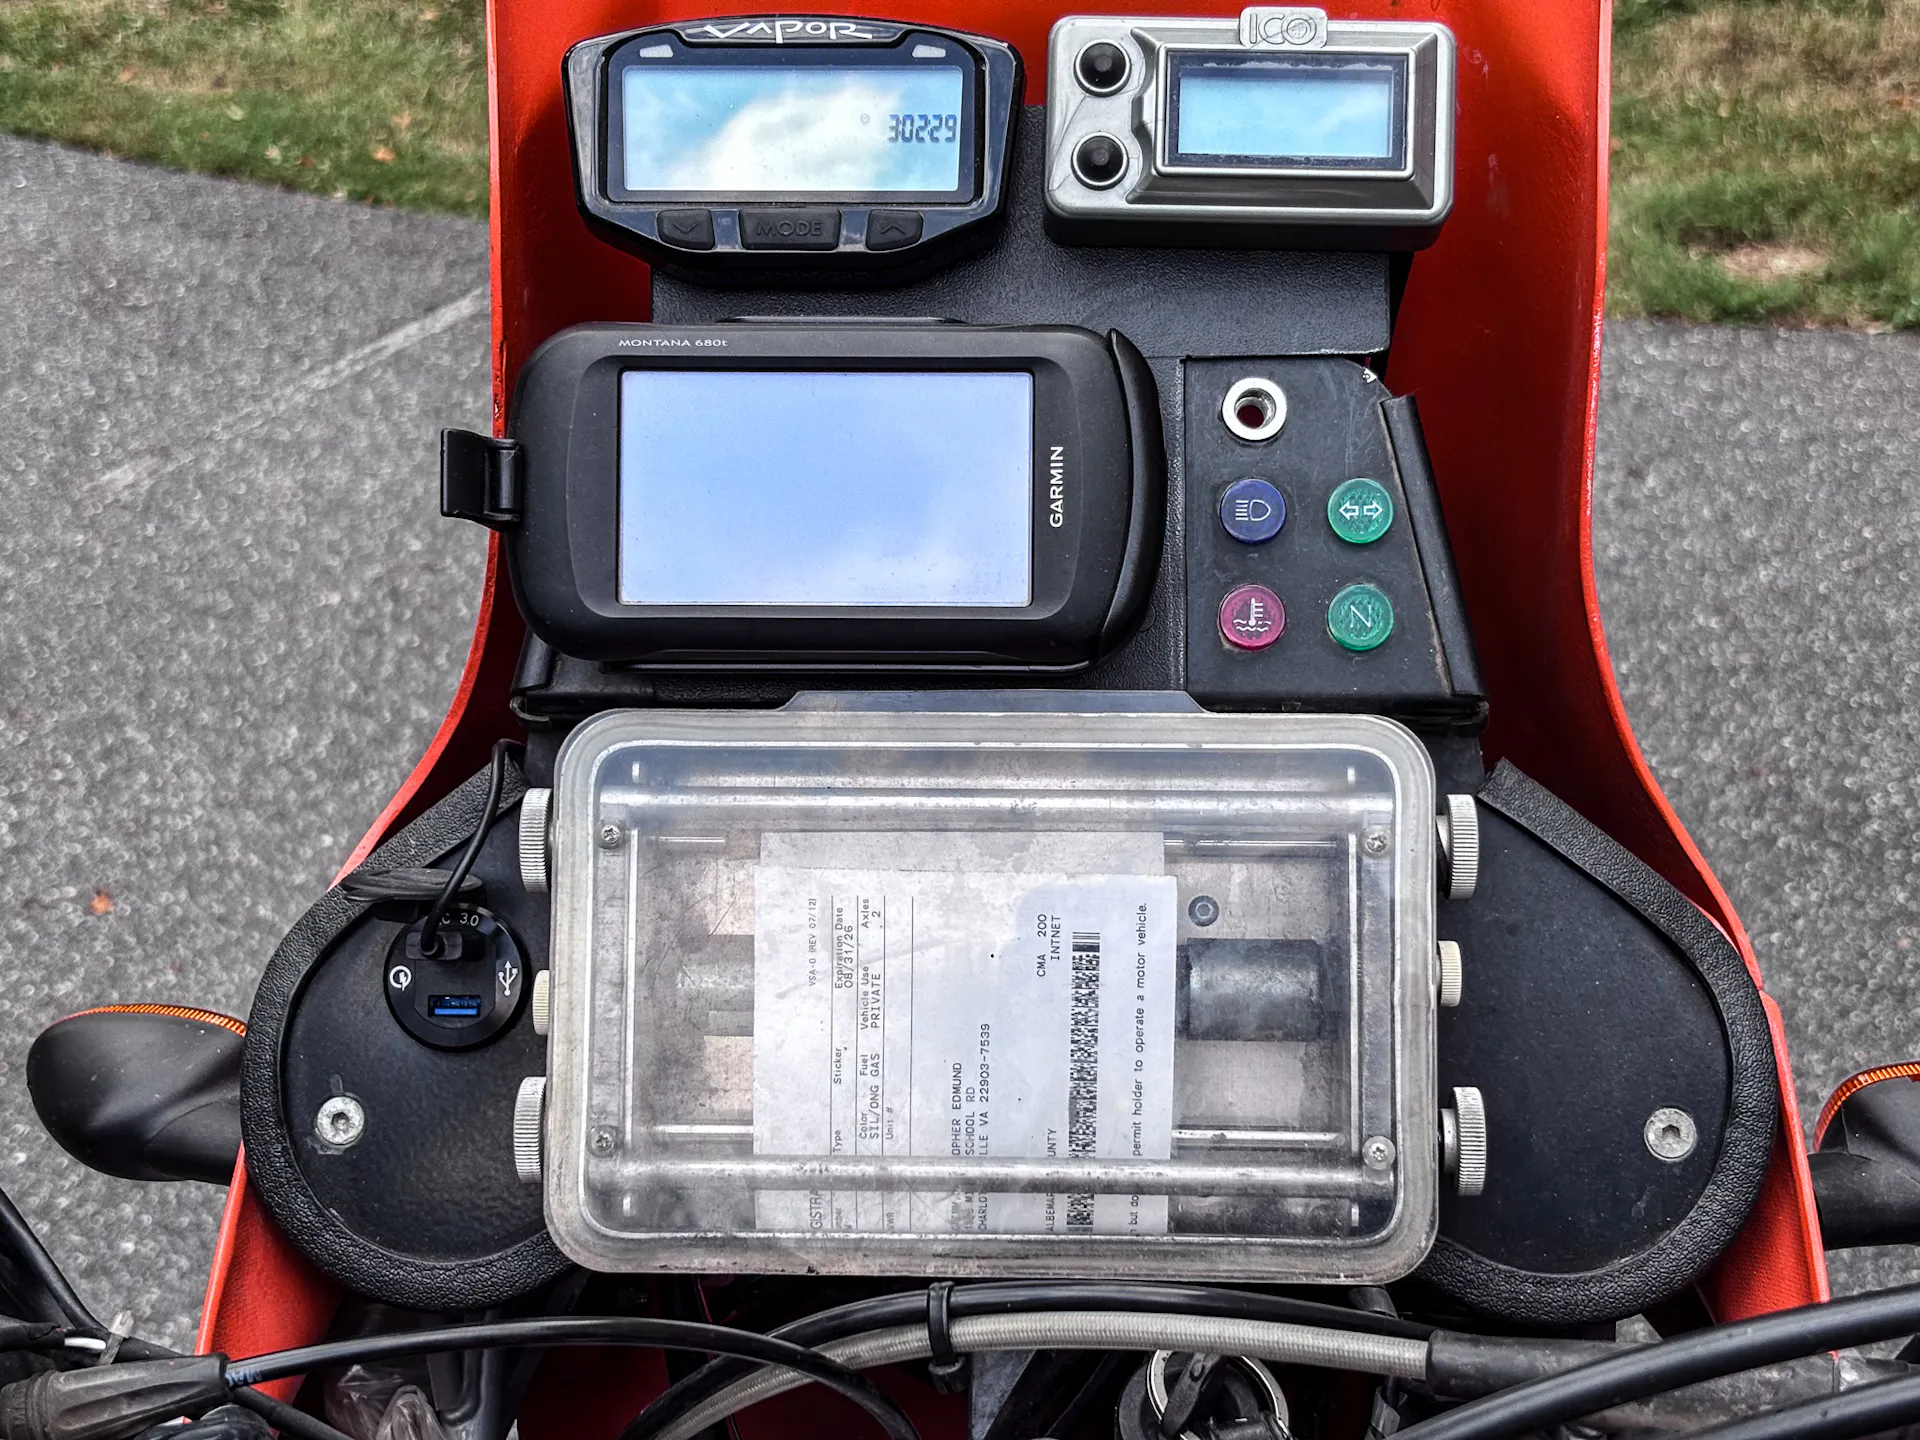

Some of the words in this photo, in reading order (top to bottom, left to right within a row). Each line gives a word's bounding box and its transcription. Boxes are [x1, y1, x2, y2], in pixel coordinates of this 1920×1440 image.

[704, 21, 873, 44] VAPOR
[1249, 12, 1317, 45] ICO
[756, 220, 823, 236] MODE
[618, 339, 691, 347] MONTANA
[695, 339, 728, 347] 680t
[1049, 445, 1064, 528] GARMIN
[1350, 604, 1372, 629] N
[459, 912, 479, 926] 3.0
[835, 907, 843, 930] Date
[861, 899, 869, 928] Axles
[1038, 914, 1047, 937] 200
[1136, 903, 1146, 945] vehicle.
[1050, 914, 1060, 960] INTNET
[835, 936, 844, 988] Expiration
[843, 926, 854, 988] 08/31/26
[1037, 954, 1046, 977] CMA
[1136, 953, 1145, 988] motor
[861, 966, 869, 984] Use
[860, 991, 869, 1030] Vehicle
[871, 973, 881, 1028] PRIVATE
[1134, 1008, 1146, 1052] operate
[833, 1047, 842, 1084] Sticker
[860, 1054, 868, 1076] Fuel
[870, 1053, 880, 1077] GAS
[980, 1023, 990, 1102] 22903-7539
[1134, 1060, 1143, 1071] to
[952, 1062, 962, 1110] EDMUND
[966, 1087, 975, 1102] RD
[1132, 1079, 1142, 1115] holder
[859, 1112, 867, 1139] Color
[979, 1111, 988, 1126] VA
[833, 1130, 842, 1152] Type
[952, 1118, 961, 1156] OPHER
[966, 1111, 975, 1156] SCHOOL
[979, 1134, 988, 1155] LLE
[1047, 1128, 1056, 1156] UNTY
[1131, 1122, 1142, 1156] permit
[810, 1190, 822, 1228] GISTRA
[1130, 1195, 1138, 1207] do
[1128, 1212, 1138, 1224] but
